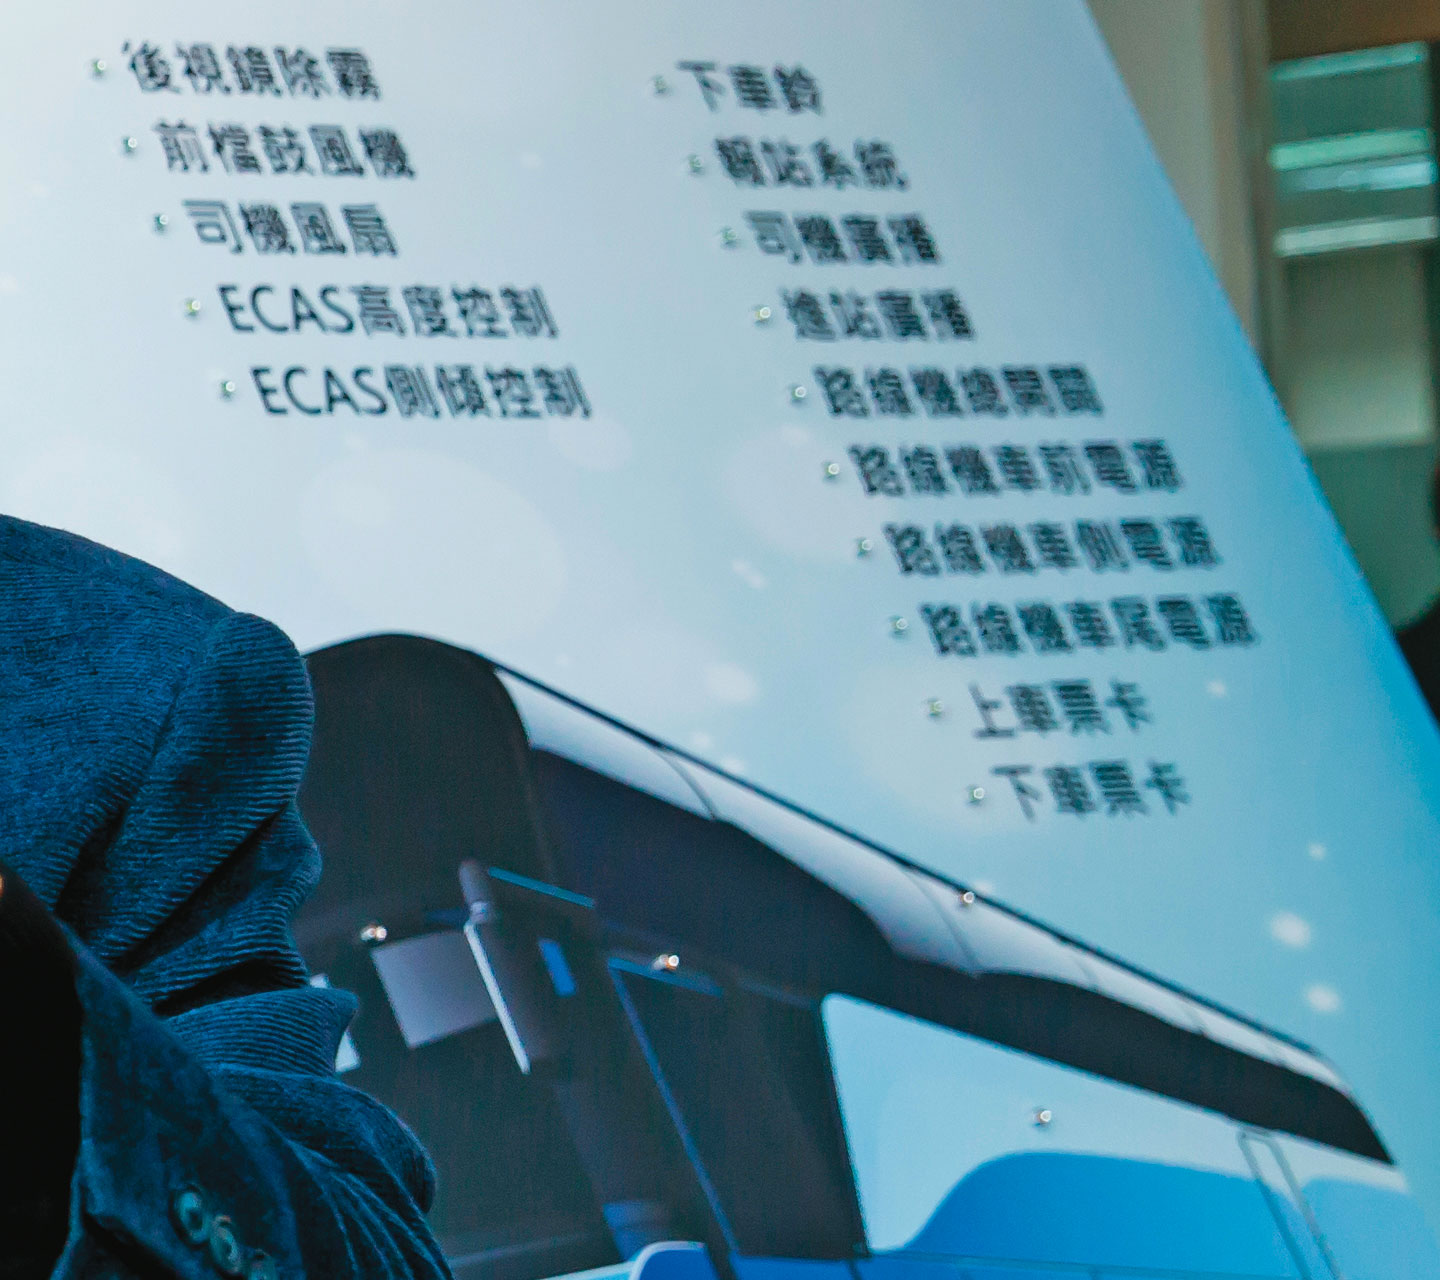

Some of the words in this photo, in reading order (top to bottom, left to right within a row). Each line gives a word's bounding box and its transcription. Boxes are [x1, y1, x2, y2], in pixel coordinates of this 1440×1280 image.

[122, 39, 383, 101] 後視鏡除霧
[676, 60, 824, 117] 下車鈴
[181, 198, 398, 257] 司機風扇
[218, 281, 561, 340] ECAS高度控制
